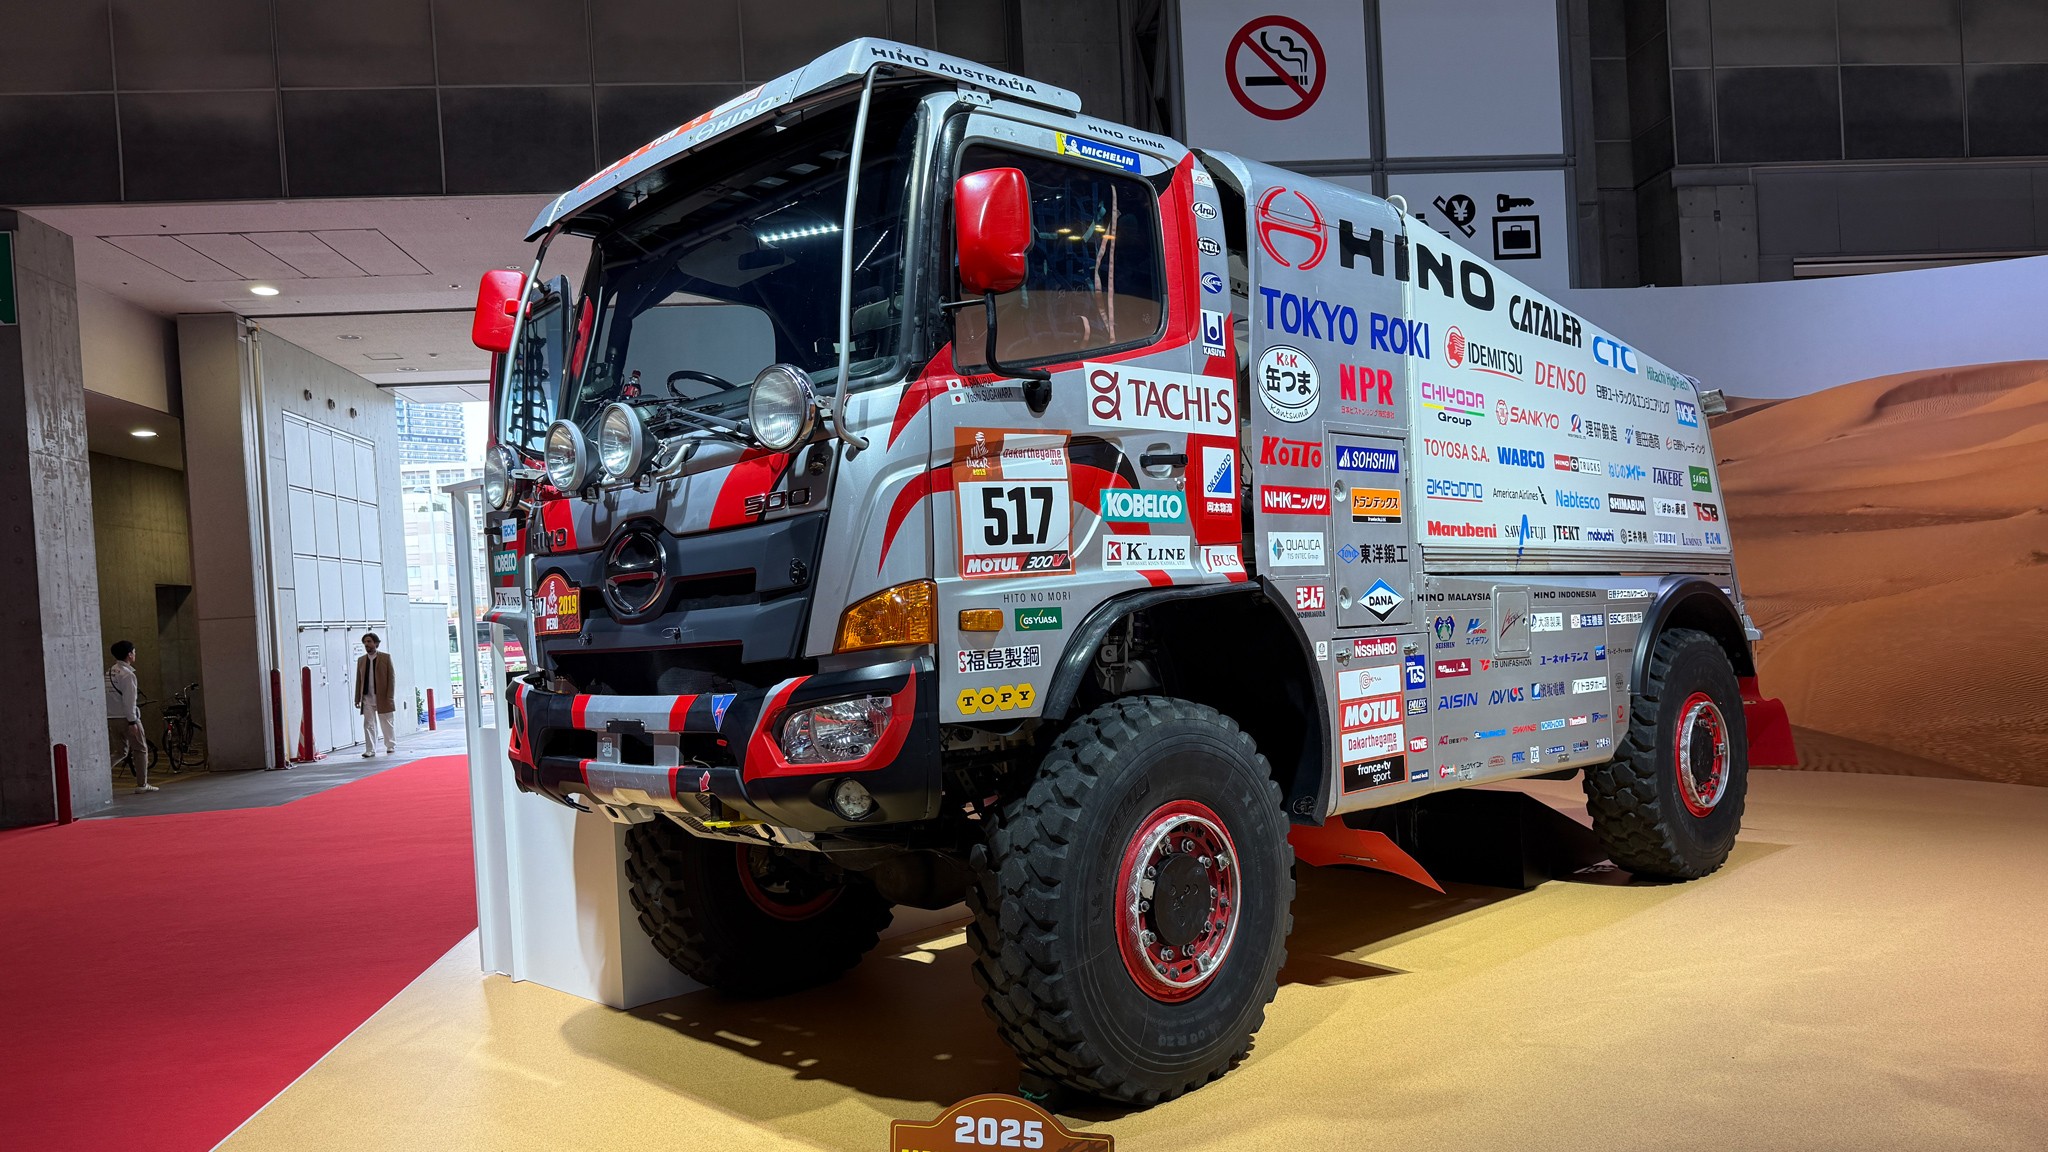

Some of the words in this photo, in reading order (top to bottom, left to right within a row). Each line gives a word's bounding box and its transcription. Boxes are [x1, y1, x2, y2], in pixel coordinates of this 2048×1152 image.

[871, 46, 929, 68] HINO
[938, 63, 1038, 95] AUSTRALIA
[714, 96, 775, 132] HINO
[1088, 124, 1124, 140] HINO
[1128, 135, 1166, 150] CHINA
[1081, 145, 1135, 167] MICHELIN
[1197, 203, 1215, 216] Arai
[1198, 240, 1220, 253] KTEL
[1339, 219, 1496, 311] HINO
[1259, 286, 1358, 346] TOKYO
[1370, 312, 1431, 360] ROKI
[1509, 295, 1582, 349] CATALER
[1203, 346, 1226, 358] KASUYA
[1276, 352, 1298, 368] K&K
[1467, 341, 1523, 375] IDEMITSU
[1592, 336, 1637, 374] CTC
[1265, 364, 1312, 396] 缶つま
[1339, 363, 1395, 406] NPR
[1535, 361, 1587, 395] DENSO
[982, 386, 1013, 401] SUGAWARA
[1127, 378, 1233, 425] TACHI-S
[1421, 382, 1485, 409] CHIYODA
[1269, 403, 1309, 420] Kantsuma
[1437, 411, 1472, 427] Group
[1510, 406, 1560, 430] SANKYO
[1003, 447, 1062, 461] Dakarthegame
[1424, 438, 1469, 460] TOYOSA
[1471, 444, 1490, 463] S.A.
[1497, 446, 1545, 469] WABCO
[1352, 450, 1397, 471] SOHSHIN
[1555, 459, 1570, 467] HINO
[1579, 461, 1601, 473] TRUCKS
[1206, 453, 1233, 494] OKAMOTO
[1652, 467, 1685, 487] TAKEBE
[1692, 474, 1708, 485] SANGO
[1427, 478, 1483, 499] akebono
[1492, 488, 1518, 499] American
[1518, 490, 1539, 501] Airlines
[744, 487, 812, 516] 500
[1106, 493, 1183, 519] KOBELCO
[1264, 490, 1327, 510] NHKニッパツ
[1353, 494, 1400, 510] トランテックス
[1556, 489, 1601, 510] Nabtesco
[1609, 497, 1646, 512] SHIMABUN
[982, 486, 1054, 546] 517
[1427, 520, 1497, 539] Marubeni
[1553, 524, 1580, 543] JTEKT
[1587, 528, 1615, 542] mabuchi
[1148, 548, 1186, 561] LINE
[1285, 539, 1321, 551] QUALICA
[1359, 543, 1408, 564] 東洋鍛工
[494, 552, 517, 573] KOBELCO
[966, 556, 1020, 574] MOTUL
[1025, 553, 1066, 569] 300V
[507, 596, 521, 606] LINE
[1003, 593, 1026, 604] HITO
[1030, 592, 1044, 602] NO
[1047, 591, 1071, 601] MORI
[1296, 586, 1324, 609] ヨシムラ
[1369, 595, 1394, 606] DANA
[1417, 593, 1444, 602] HINO
[1448, 592, 1491, 601] MALAYSIA
[1534, 590, 1556, 599] HINO
[1558, 590, 1597, 599] INDONESIA
[558, 595, 577, 615] 2019
[1023, 615, 1034, 625] GS
[1033, 613, 1058, 624] YUASA
[1609, 613, 1622, 624] SSC
[1354, 639, 1397, 658] NISSHINBO
[1435, 641, 1456, 650] SEISHIN
[1466, 636, 1489, 646] エイチワン
[967, 646, 1040, 672] 福島製鋼
[1491, 661, 1499, 669] TB
[1499, 659, 1532, 668] UNIFASHION
[1406, 665, 1425, 684] T&S
[962, 690, 1030, 707] TOPY
[1437, 692, 1478, 710] AISIN
[1344, 699, 1400, 728] MOTUL
[1512, 723, 1537, 735] SWANS
[1348, 731, 1397, 752] Dakarthegame
[1385, 742, 1398, 754] .com
[1409, 739, 1428, 751] TONE
[1372, 771, 1392, 785] sport
[955, 1115, 1044, 1149] 2025
